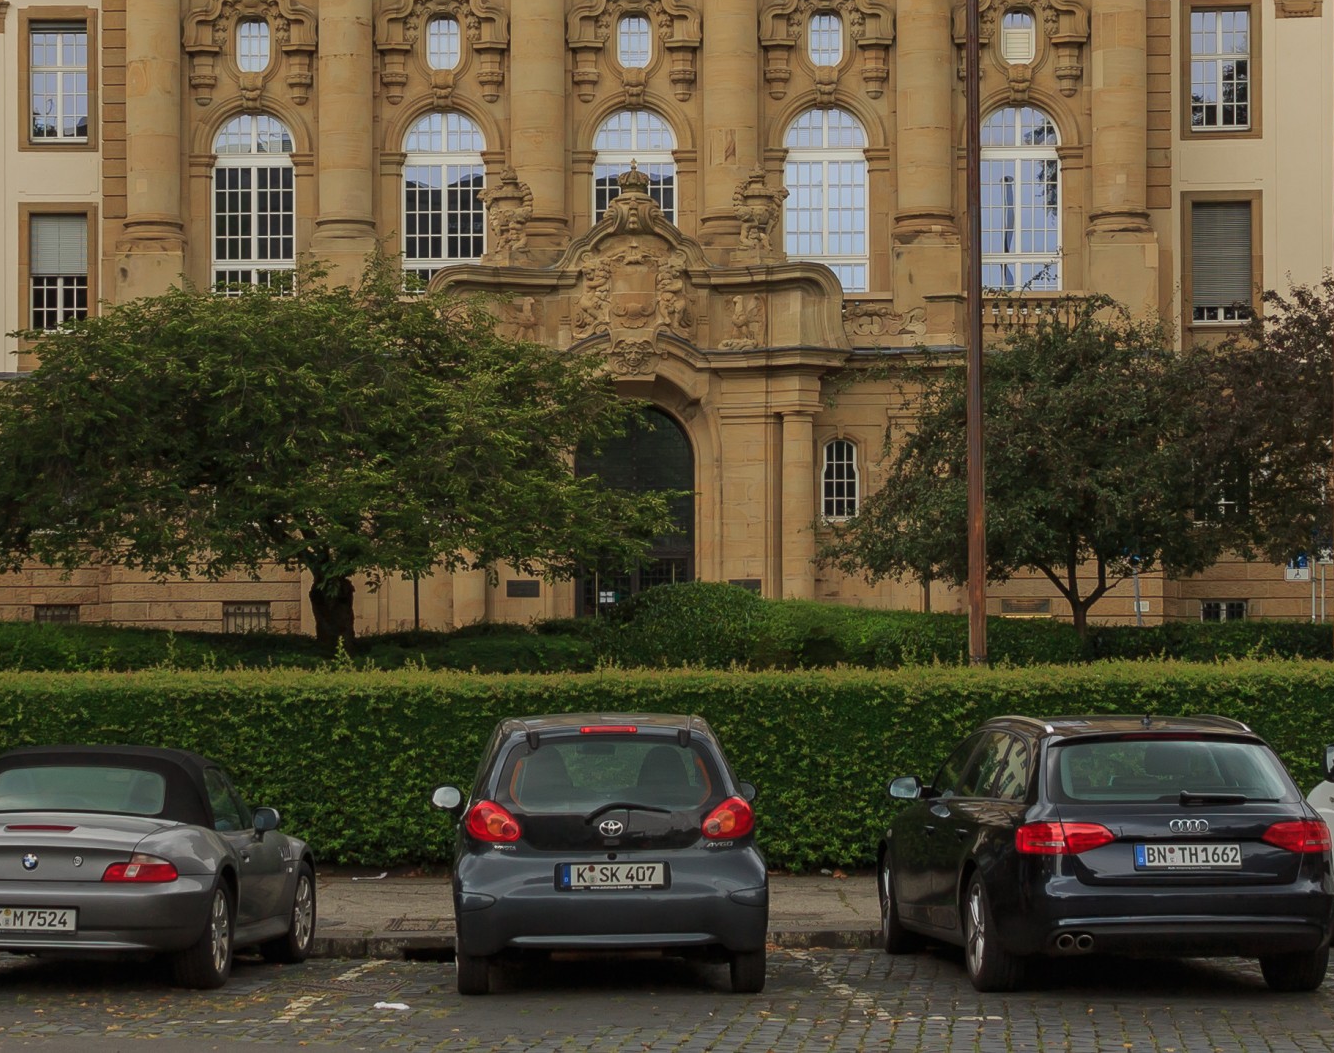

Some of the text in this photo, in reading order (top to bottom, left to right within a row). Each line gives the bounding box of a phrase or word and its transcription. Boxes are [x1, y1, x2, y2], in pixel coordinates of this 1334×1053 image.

[1147, 847, 1167, 863] BN
[577, 866, 656, 883] K SK 407
[13, 911, 24, 927] M
[27, 911, 68, 927] 7524
